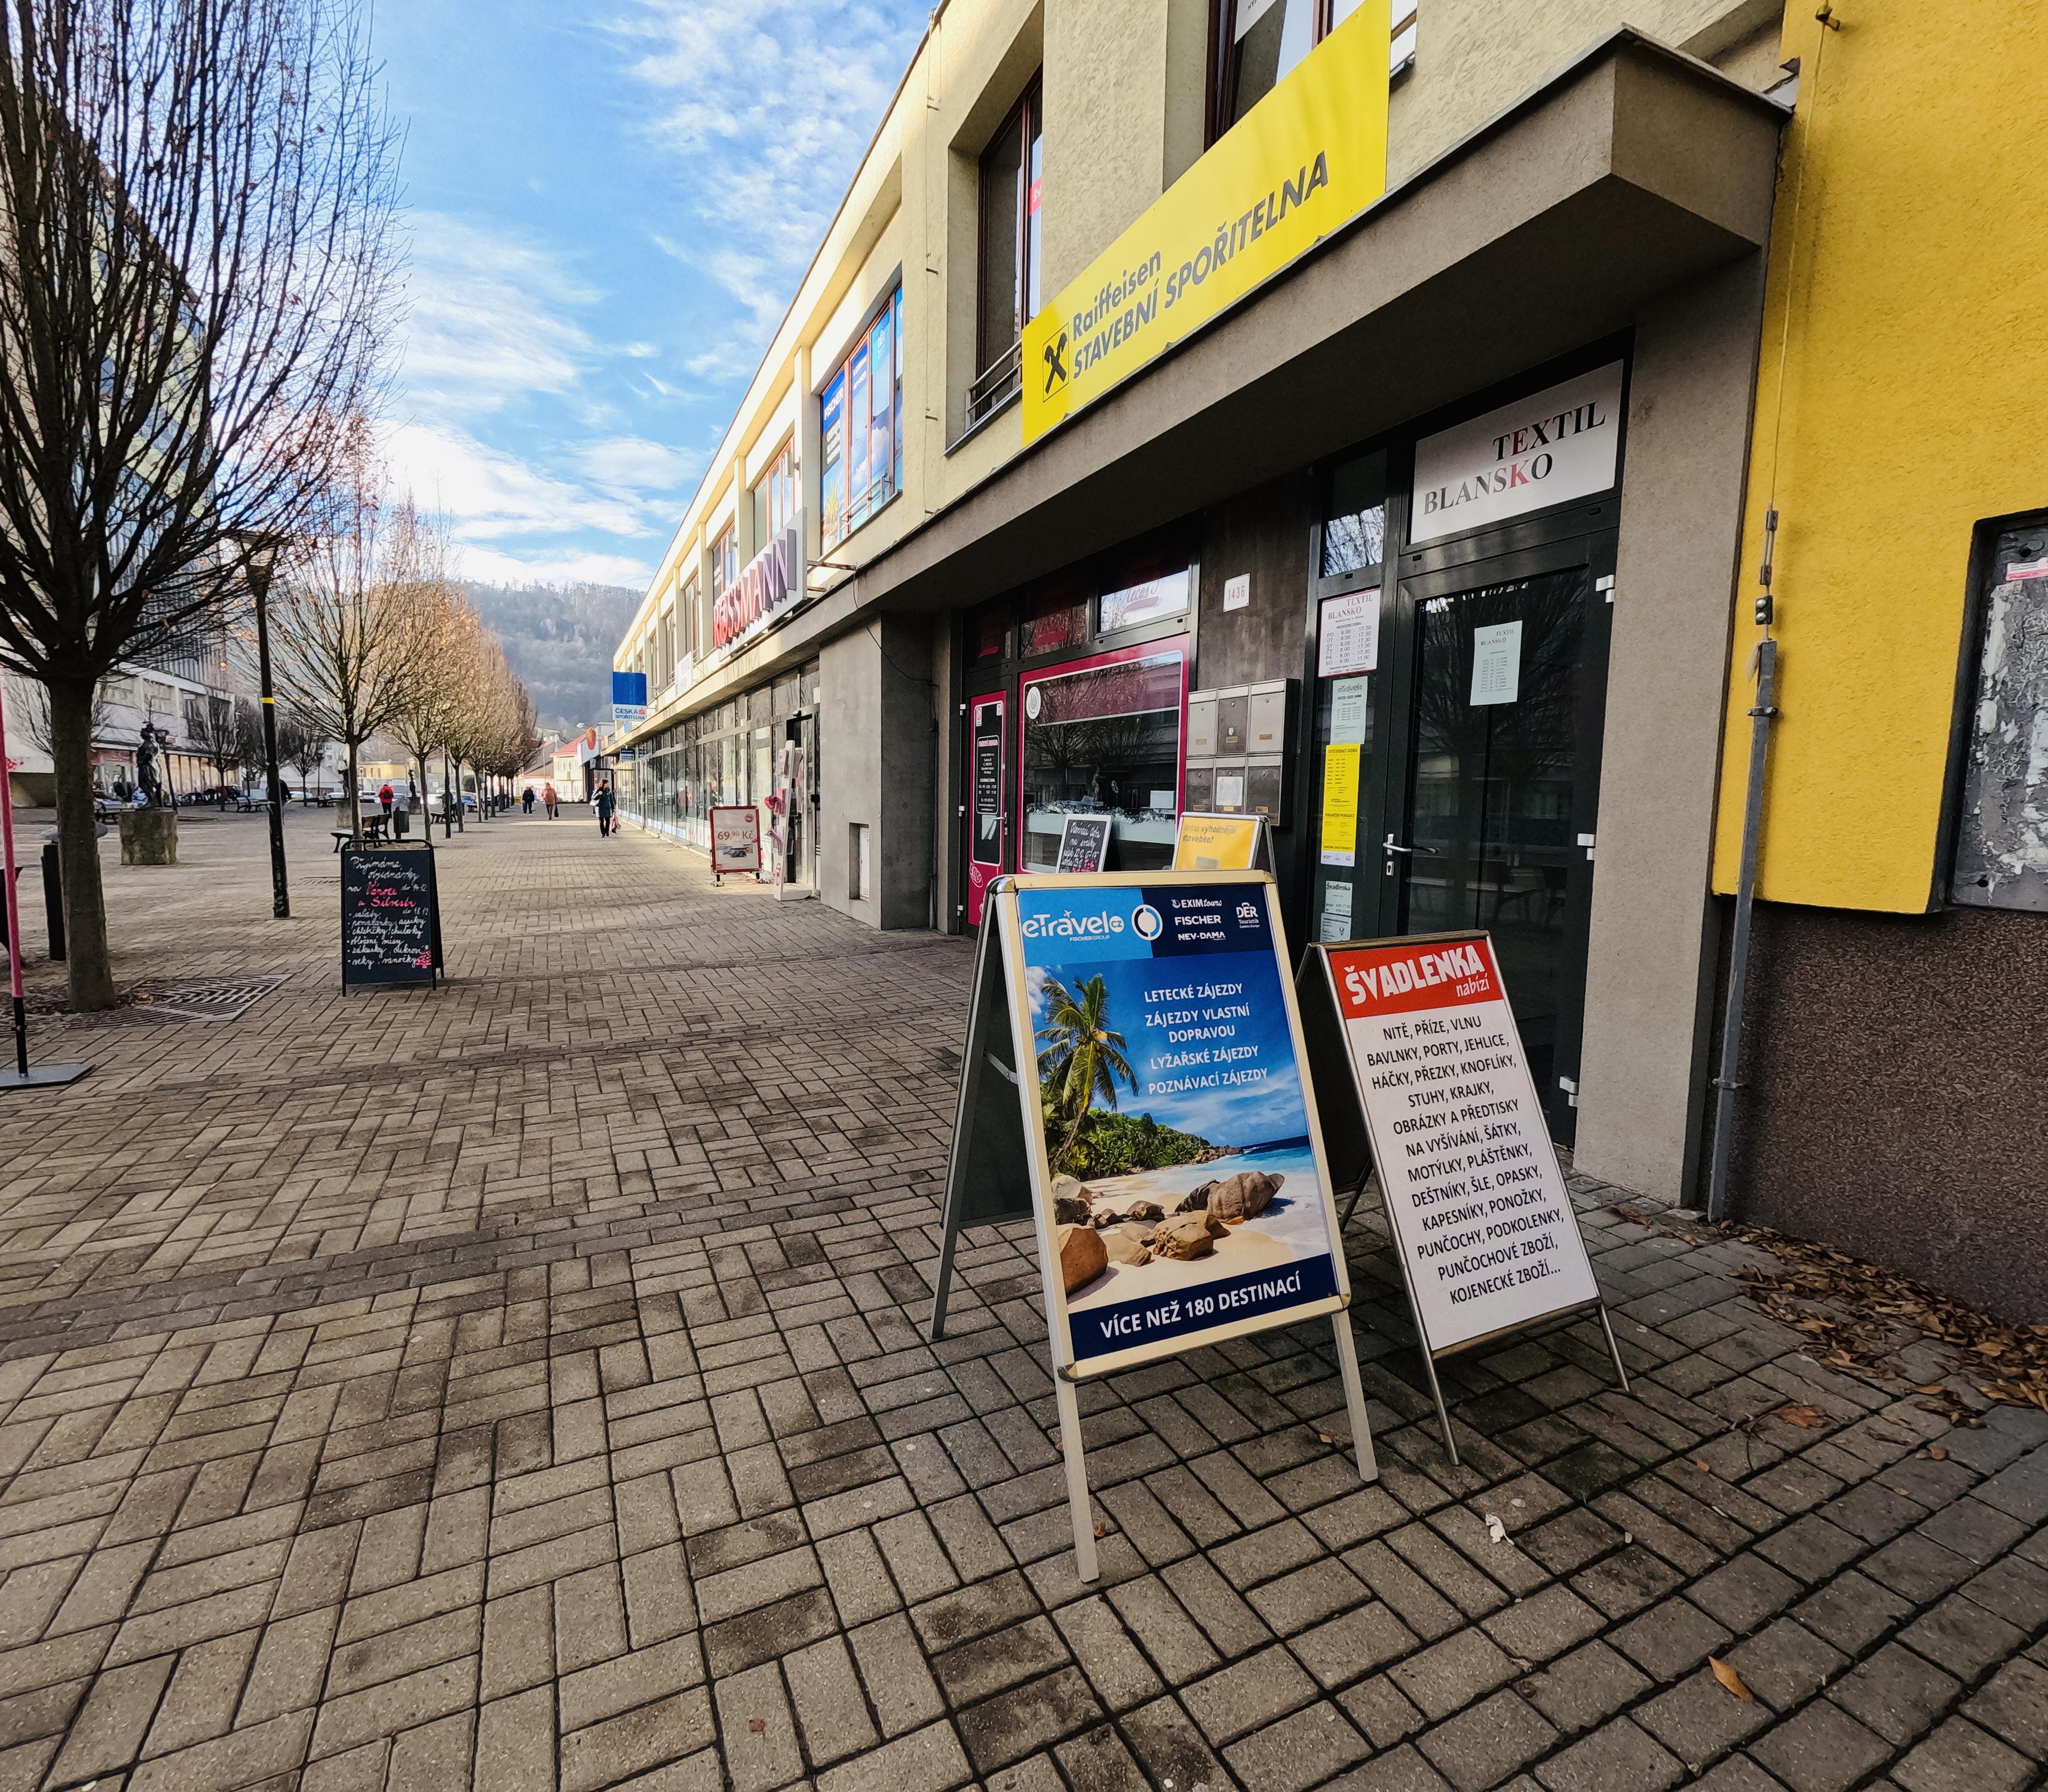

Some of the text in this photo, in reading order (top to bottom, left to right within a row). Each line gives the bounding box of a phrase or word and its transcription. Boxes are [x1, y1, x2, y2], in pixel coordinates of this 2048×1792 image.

[1073, 150, 1328, 379] STAVEBNÍ SPOŘITELNA
[1073, 251, 1161, 342] Raiffeisen
[824, 387, 844, 421] FISCHER
[1492, 401, 1606, 462] TEXTIL
[1422, 453, 1553, 515] BLANSKO
[713, 529, 796, 649] ROSSMANN
[1228, 585, 1245, 602] 1436
[1347, 594, 1373, 606] TEXTIL
[1328, 606, 1362, 619] BLANSKO
[1480, 637, 1506, 646] BLANSKO
[742, 830, 754, 839] Kč
[1183, 835, 1214, 843] stavebko?
[350, 857, 401, 874] Přijímáme
[368, 867, 419, 885] objednávky
[366, 881, 397, 895] Vánoce
[1326, 882, 1351, 891] Švadlenka
[370, 896, 416, 907] Silvestr
[1236, 904, 1258, 918] DER
[1022, 910, 1109, 938] eTravel
[1175, 915, 1221, 926] FISCHER
[350, 935, 378, 945] obložené
[1178, 931, 1226, 941] NEV-DAMA
[1343, 944, 1485, 1005] ŠVADLENKA
[1456, 972, 1490, 998] nabízí
[1144, 983, 1243, 1003] LETECKÉ ZÁJEZDY
[1145, 1002, 1250, 1028] ZÁJEZDY VLASTNÍ
[1382, 1015, 1482, 1041] NITĚ, PŘÍZE, VLNU
[1169, 1024, 1235, 1044] DOPRAVOU
[1150, 1045, 1258, 1070] LYŽAŘSKÉ ZÁJEZDY
[1367, 1033, 1510, 1066] BAVLNKY, PORTY, JEHLICE,
[1148, 1067, 1268, 1095] POZNÁVACÍ ZÁJEZDY
[1372, 1053, 1516, 1090] HÁČKY, PŘEZKY, KNOFLÍKY,
[1408, 1081, 1494, 1107] STUHY, KRAJKY,
[1393, 1098, 1519, 1135] OBRÁZKY A PŘEDTISKY
[1406, 1122, 1521, 1157] NA VYŠÍVÁNÍ, ŠÁTKY,
[1408, 1143, 1532, 1182] MOTÝLKY, PLÁŠTĚNKY,
[1412, 1165, 1542, 1207] DEŠTNÍKY, ŠLE, OPASKY,
[1422, 1188, 1546, 1232] KAPESNÍKY, PONOŽKY,
[1417, 1208, 1564, 1260] PUNČOCHY, PODKOLENKY,
[1438, 1232, 1558, 1281] PUNČOCHOVÉ ZBOŽÍ,
[1450, 1259, 1561, 1305] KOJENECKÉ ZBOŽÍ...
[1100, 1271, 1301, 1339] VÍCE NEŽ 180 DESTINACÍ
